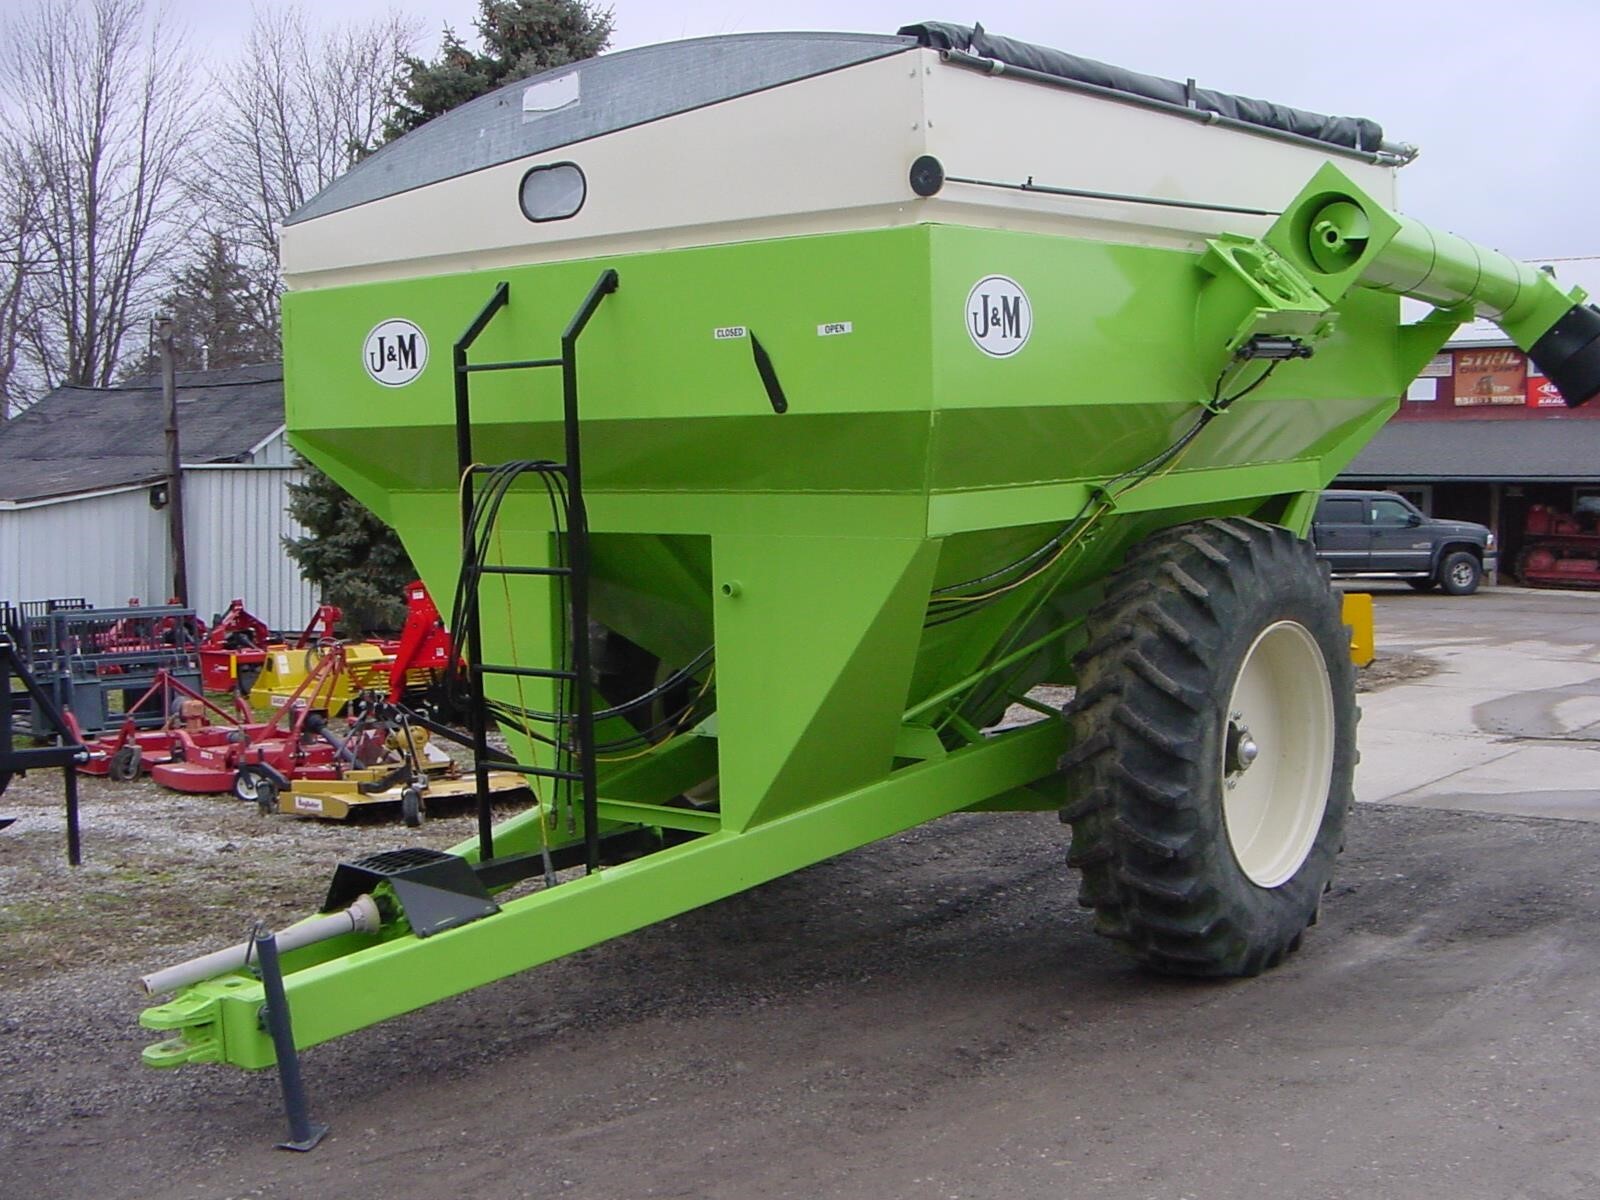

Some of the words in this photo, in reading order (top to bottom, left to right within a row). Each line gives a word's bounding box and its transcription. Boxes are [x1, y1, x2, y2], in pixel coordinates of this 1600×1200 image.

[972, 294, 1022, 338] J&M
[716, 328, 744, 338] CLOSED
[824, 324, 846, 334] OPEN
[369, 333, 418, 373] J&M
